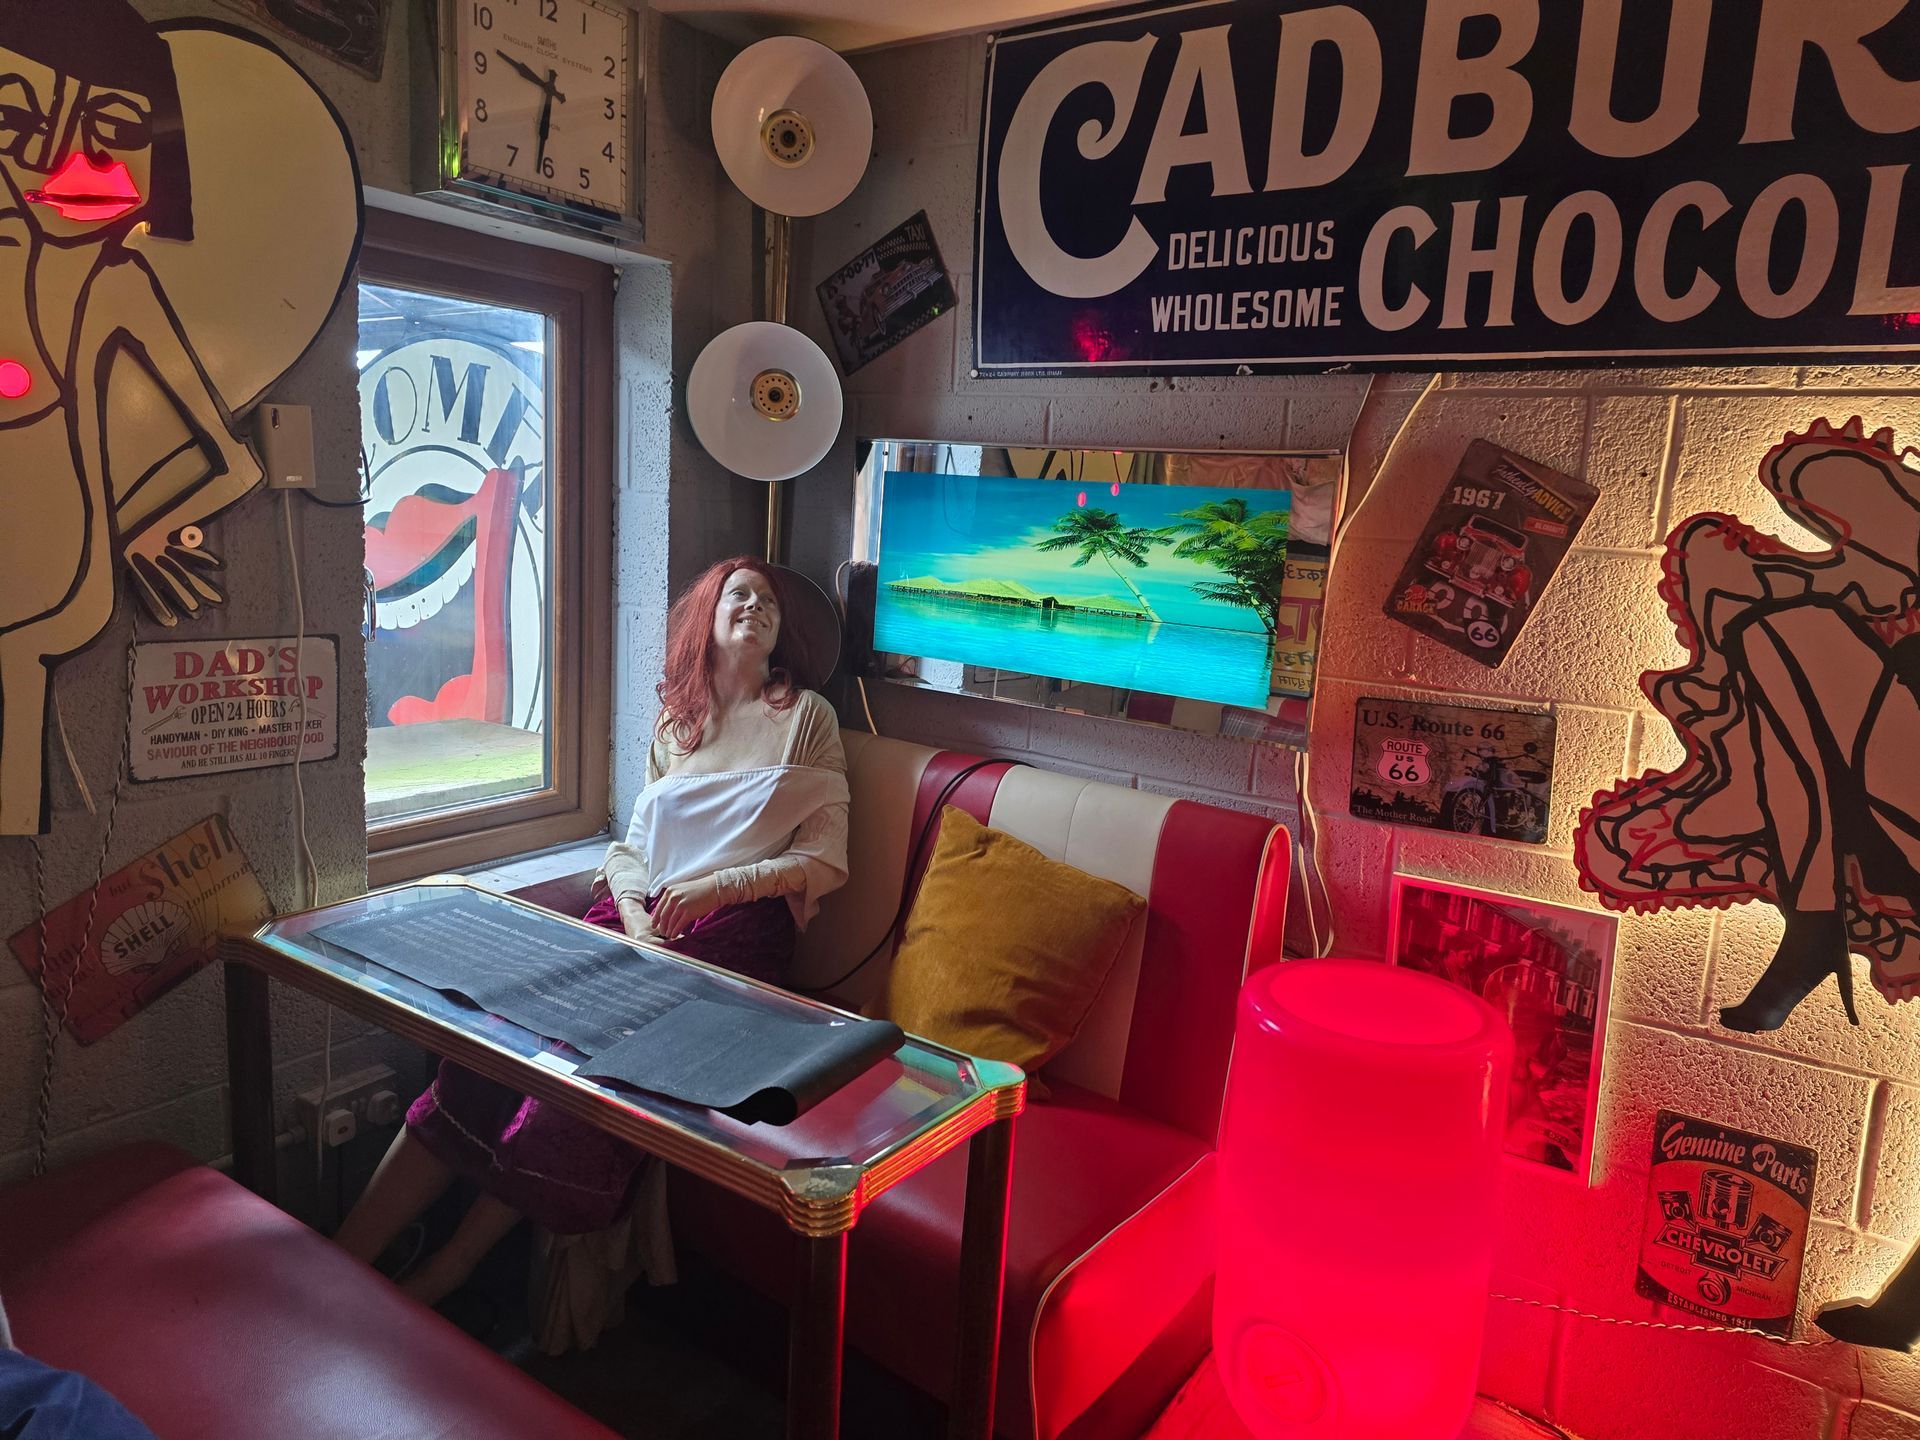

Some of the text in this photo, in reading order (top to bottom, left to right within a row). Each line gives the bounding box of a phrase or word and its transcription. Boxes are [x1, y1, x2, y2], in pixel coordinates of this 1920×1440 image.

[473, 3, 493, 30] 10
[539, 0, 558, 23] 12
[581, 12, 587, 35] 1
[474, 51, 487, 75] 9
[503, 32, 533, 49] ENGLISH
[562, 57, 593, 73] SYSTEMS
[603, 56, 616, 79] 2
[475, 98, 488, 123] 8
[603, 97, 615, 120] 3
[506, 144, 519, 167] 7
[601, 141, 615, 164] 4
[998, 0, 1920, 299] CADBUR
[542, 156, 555, 179] 6
[578, 167, 590, 189] 5
[904, 223, 926, 241] TAXI
[1167, 220, 1335, 271] DELICIOUS
[1358, 163, 1920, 332] CHOCOL
[1150, 286, 1345, 333] WHOLESOME
[1453, 486, 1506, 510] 1967
[1533, 488, 1574, 522] ADVICE
[1471, 626, 1498, 643] 66
[174, 646, 299, 680] DAD'S
[143, 676, 323, 714] WORKSHOP
[191, 699, 287, 725] OPEN 24 HOURS
[150, 731, 200, 746] HANDYMAN
[211, 728, 226, 740] DIY
[228, 726, 249, 738] KING
[259, 723, 292, 735] MASTER
[1362, 709, 1506, 741] U.S. Route 66
[147, 732, 324, 761] SAVIOUR OF THE NEIGHBOUROOD
[181, 748, 296, 769] AND HE STILL HAS ALL 10 FINGERS
[1387, 740, 1423, 754] ROUTE
[1388, 764, 1420, 782] 66
[1375, 808, 1407, 820] Mother
[139, 816, 233, 902] Shell
[113, 914, 174, 960] SHELL
[1661, 1120, 1808, 1195] Genuine Parts
[1666, 1230, 1774, 1275] CHEVROLET
[1660, 1260, 1693, 1276] DETROIT
[1736, 1285, 1772, 1302] MICHIGAN
[1667, 1291, 1727, 1325] ESTABLISHED
